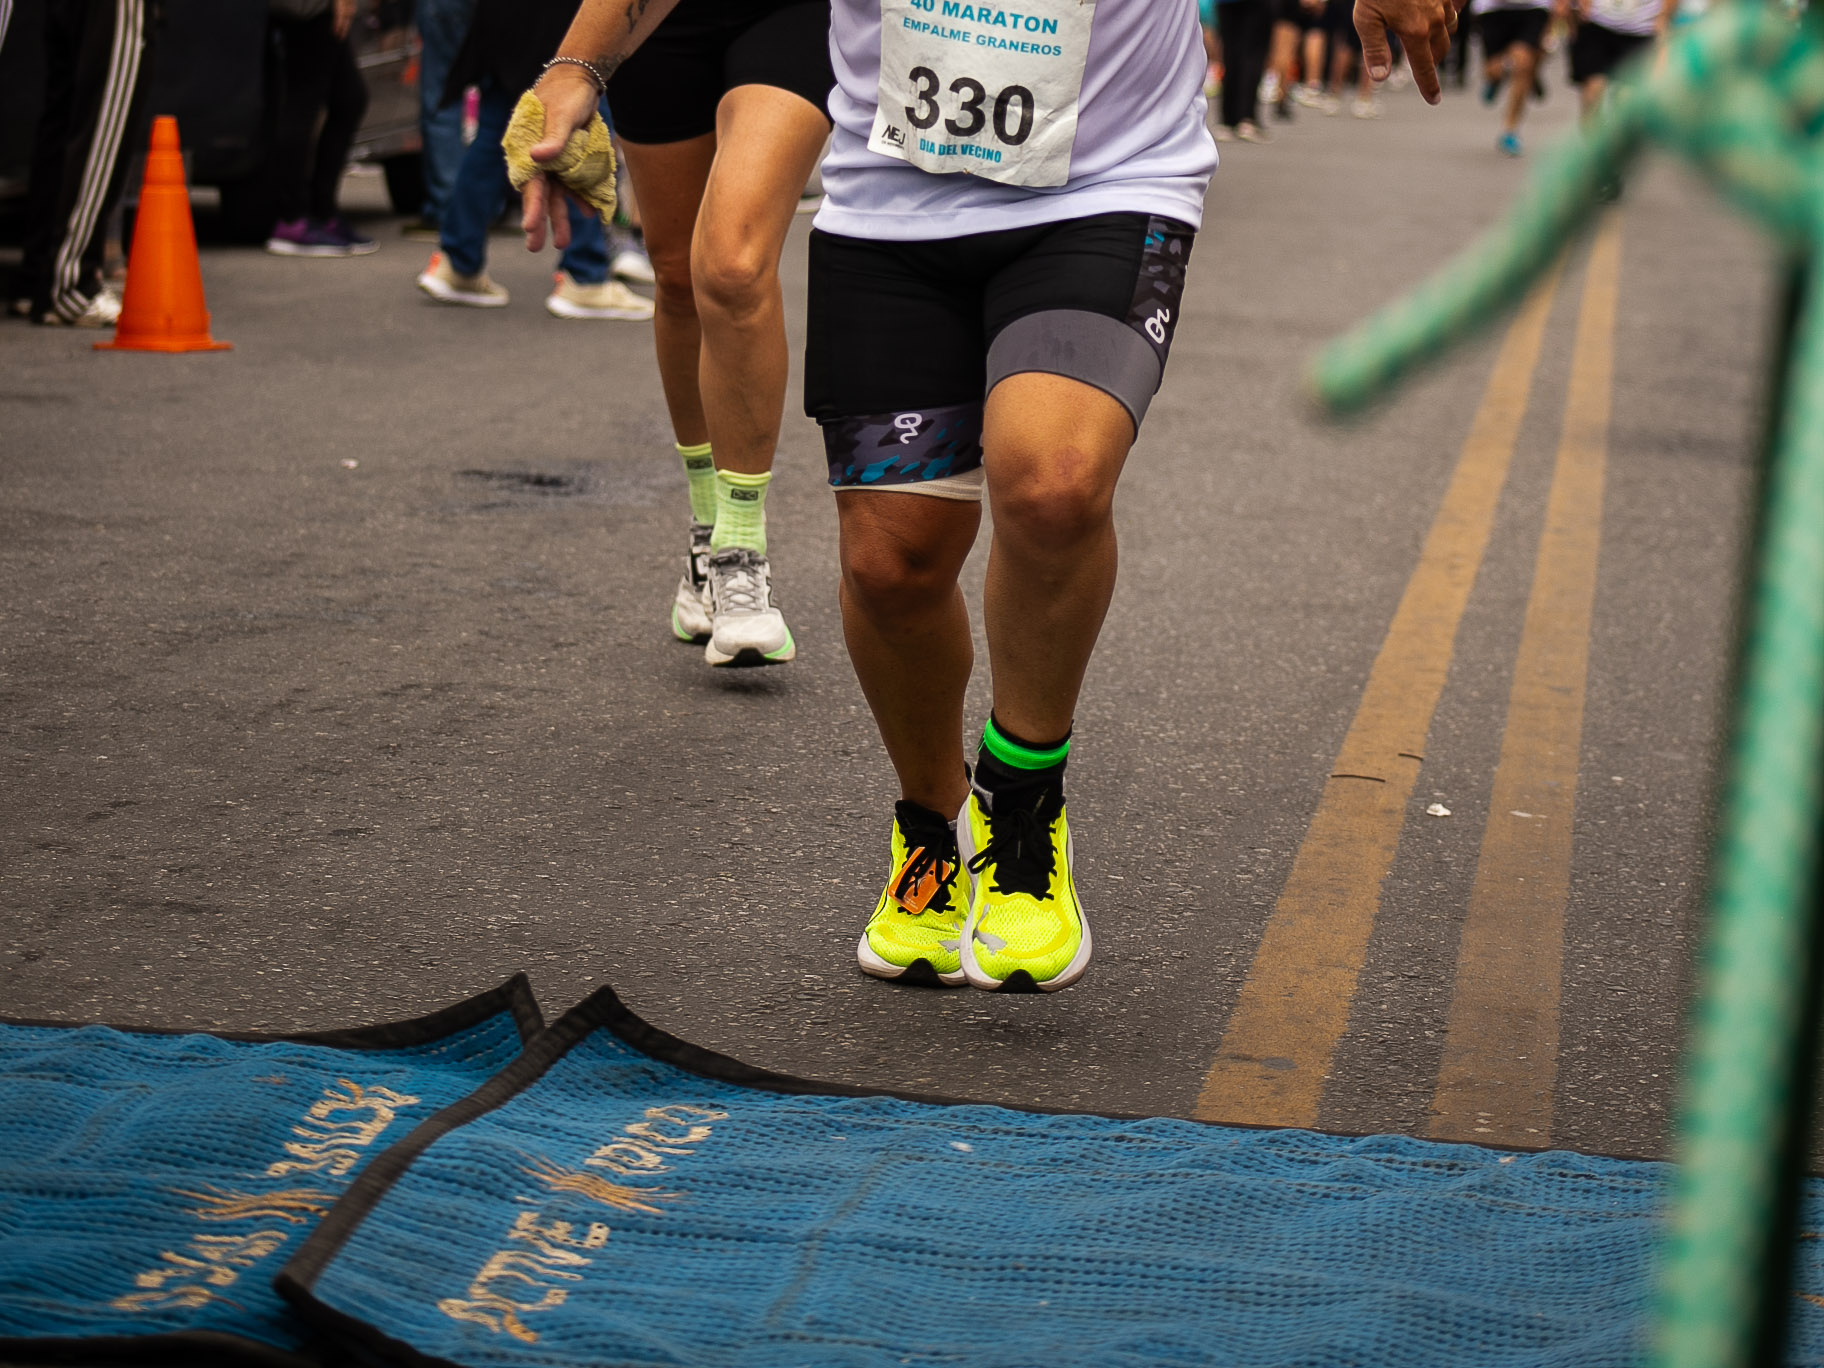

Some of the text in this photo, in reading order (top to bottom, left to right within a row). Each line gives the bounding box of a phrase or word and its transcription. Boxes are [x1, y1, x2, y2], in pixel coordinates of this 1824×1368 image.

[941, 0, 1059, 35] MARATON
[903, 16, 1062, 57] EMPALME GRANEROS
[904, 65, 1035, 146] 330
[881, 124, 906, 146] NEJ
[919, 138, 936, 155] DIA
[938, 142, 958, 156] DEL
[960, 143, 1002, 164] VECINO
